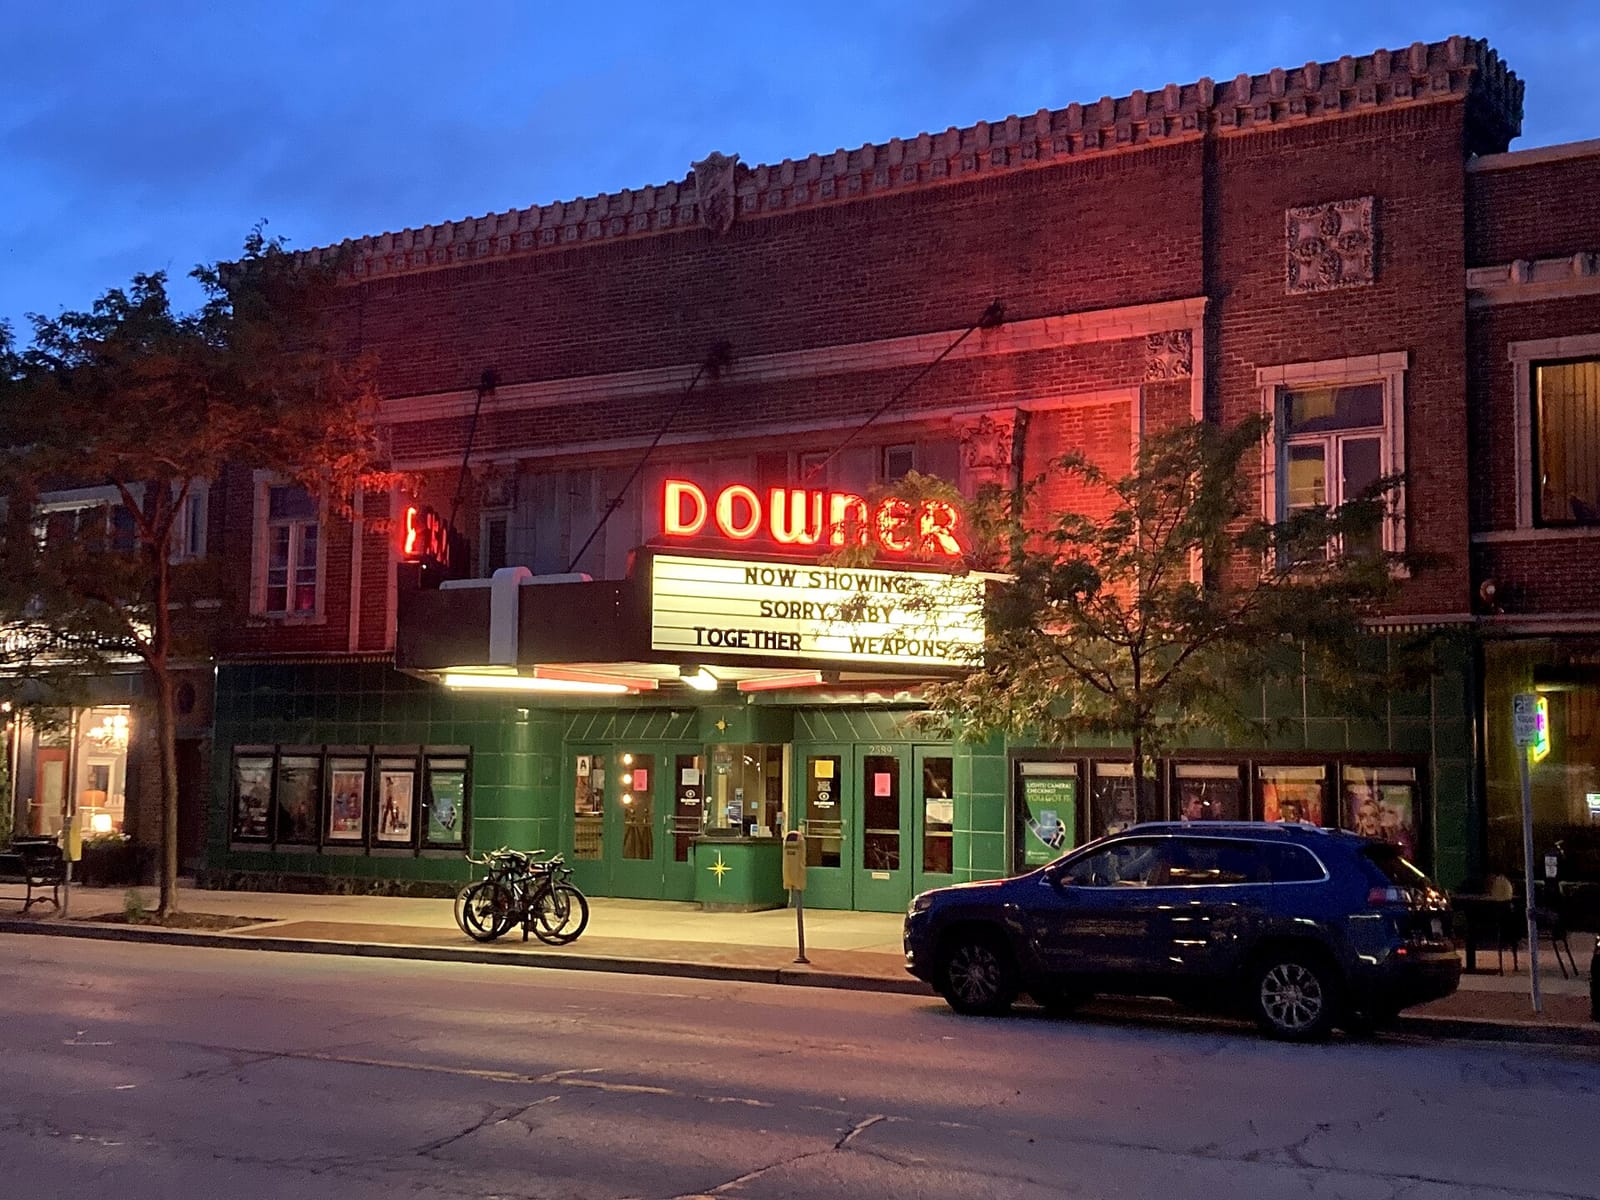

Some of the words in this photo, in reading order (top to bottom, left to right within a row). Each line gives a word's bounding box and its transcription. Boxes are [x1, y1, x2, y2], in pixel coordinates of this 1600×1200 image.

[665, 480, 961, 555] DOWNER
[744, 566, 797, 588] NOW
[808, 570, 908, 594] SHOWING
[693, 626, 802, 651] TOGETHER
[849, 635, 947, 658] WEAPONS
